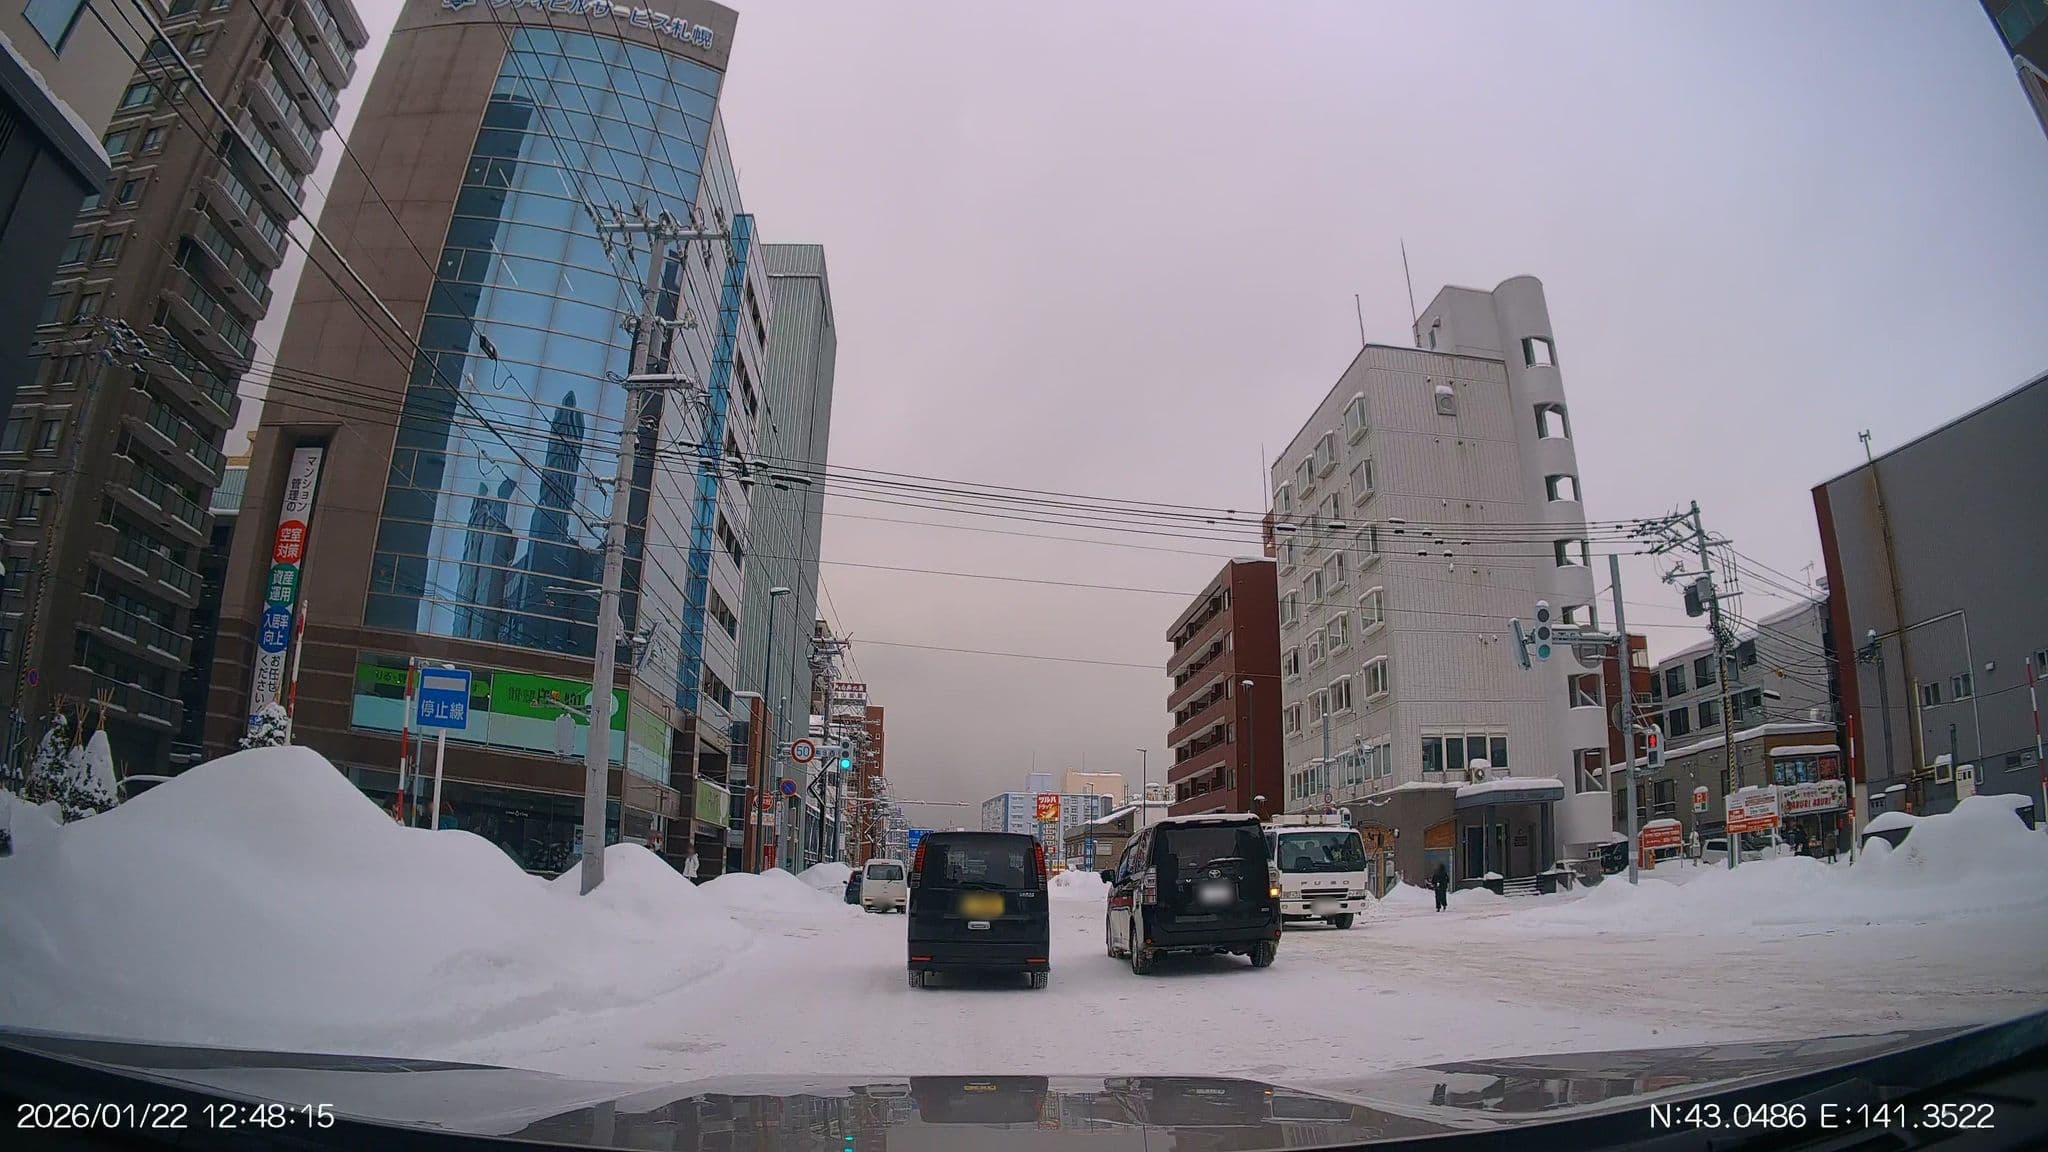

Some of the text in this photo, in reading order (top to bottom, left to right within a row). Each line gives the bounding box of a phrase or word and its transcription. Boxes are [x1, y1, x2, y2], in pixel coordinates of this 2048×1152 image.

[296, 456, 317, 512] マンション
[286, 478, 302, 512] 管理の
[279, 528, 302, 543] 空室
[276, 544, 299, 558] 対策
[272, 569, 294, 586] 資産
[269, 586, 291, 602] 運用
[263, 613, 289, 629] 入居率
[263, 631, 284, 646] 向上
[268, 655, 281, 693] お任せ
[421, 699, 464, 720] 停止線
[796, 745, 810, 757] 50
[1696, 793, 1703, 803] P
